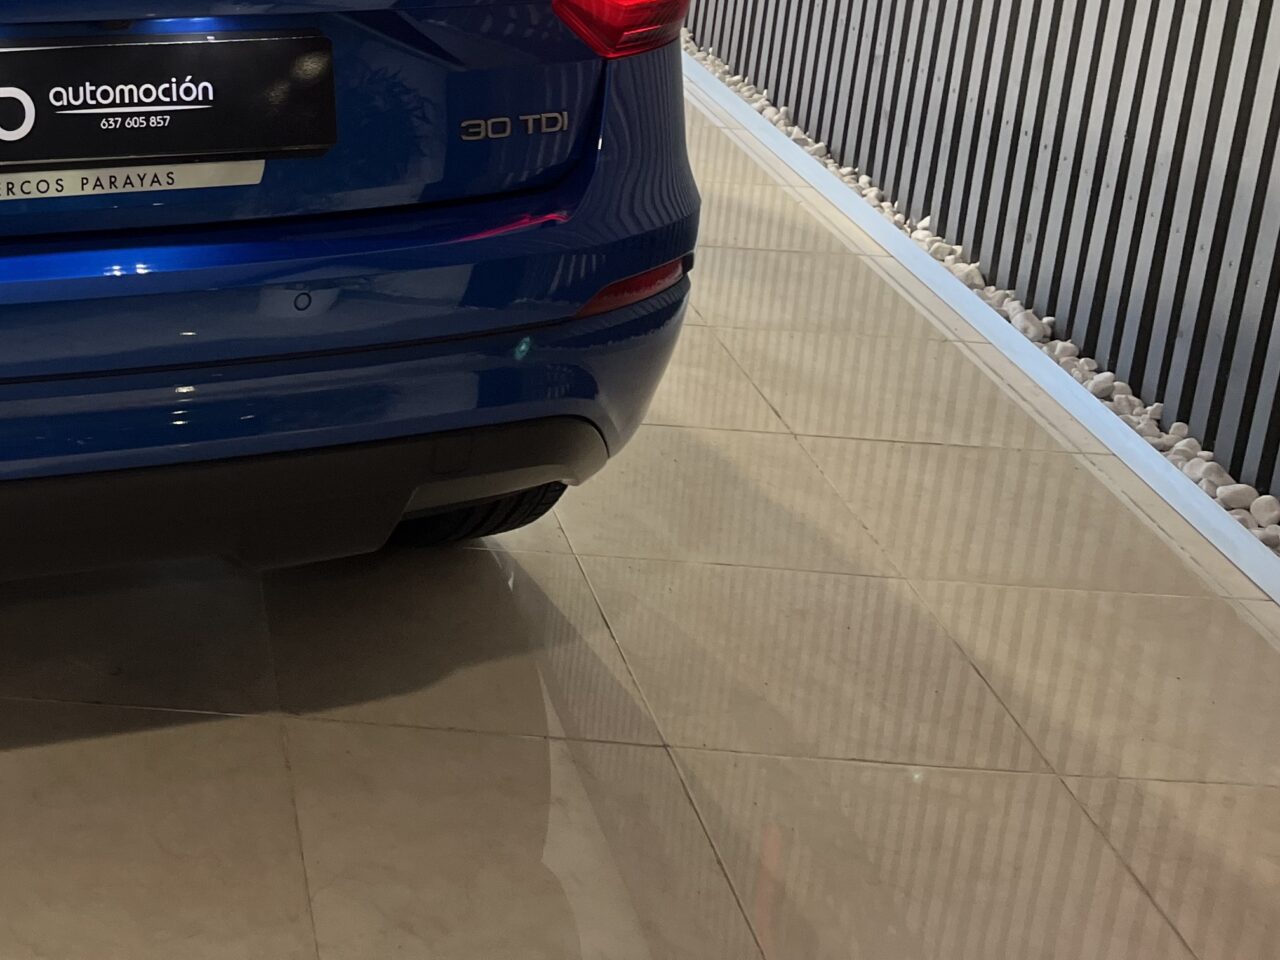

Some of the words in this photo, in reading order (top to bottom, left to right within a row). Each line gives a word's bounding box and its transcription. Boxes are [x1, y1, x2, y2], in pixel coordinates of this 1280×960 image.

[49, 75, 214, 106] automoción
[100, 117, 122, 129] 637
[124, 116, 147, 128] 605
[149, 115, 171, 127] 857
[460, 117, 512, 141] 30
[518, 111, 569, 135] TDI
[80, 171, 176, 192] PARAYAS
